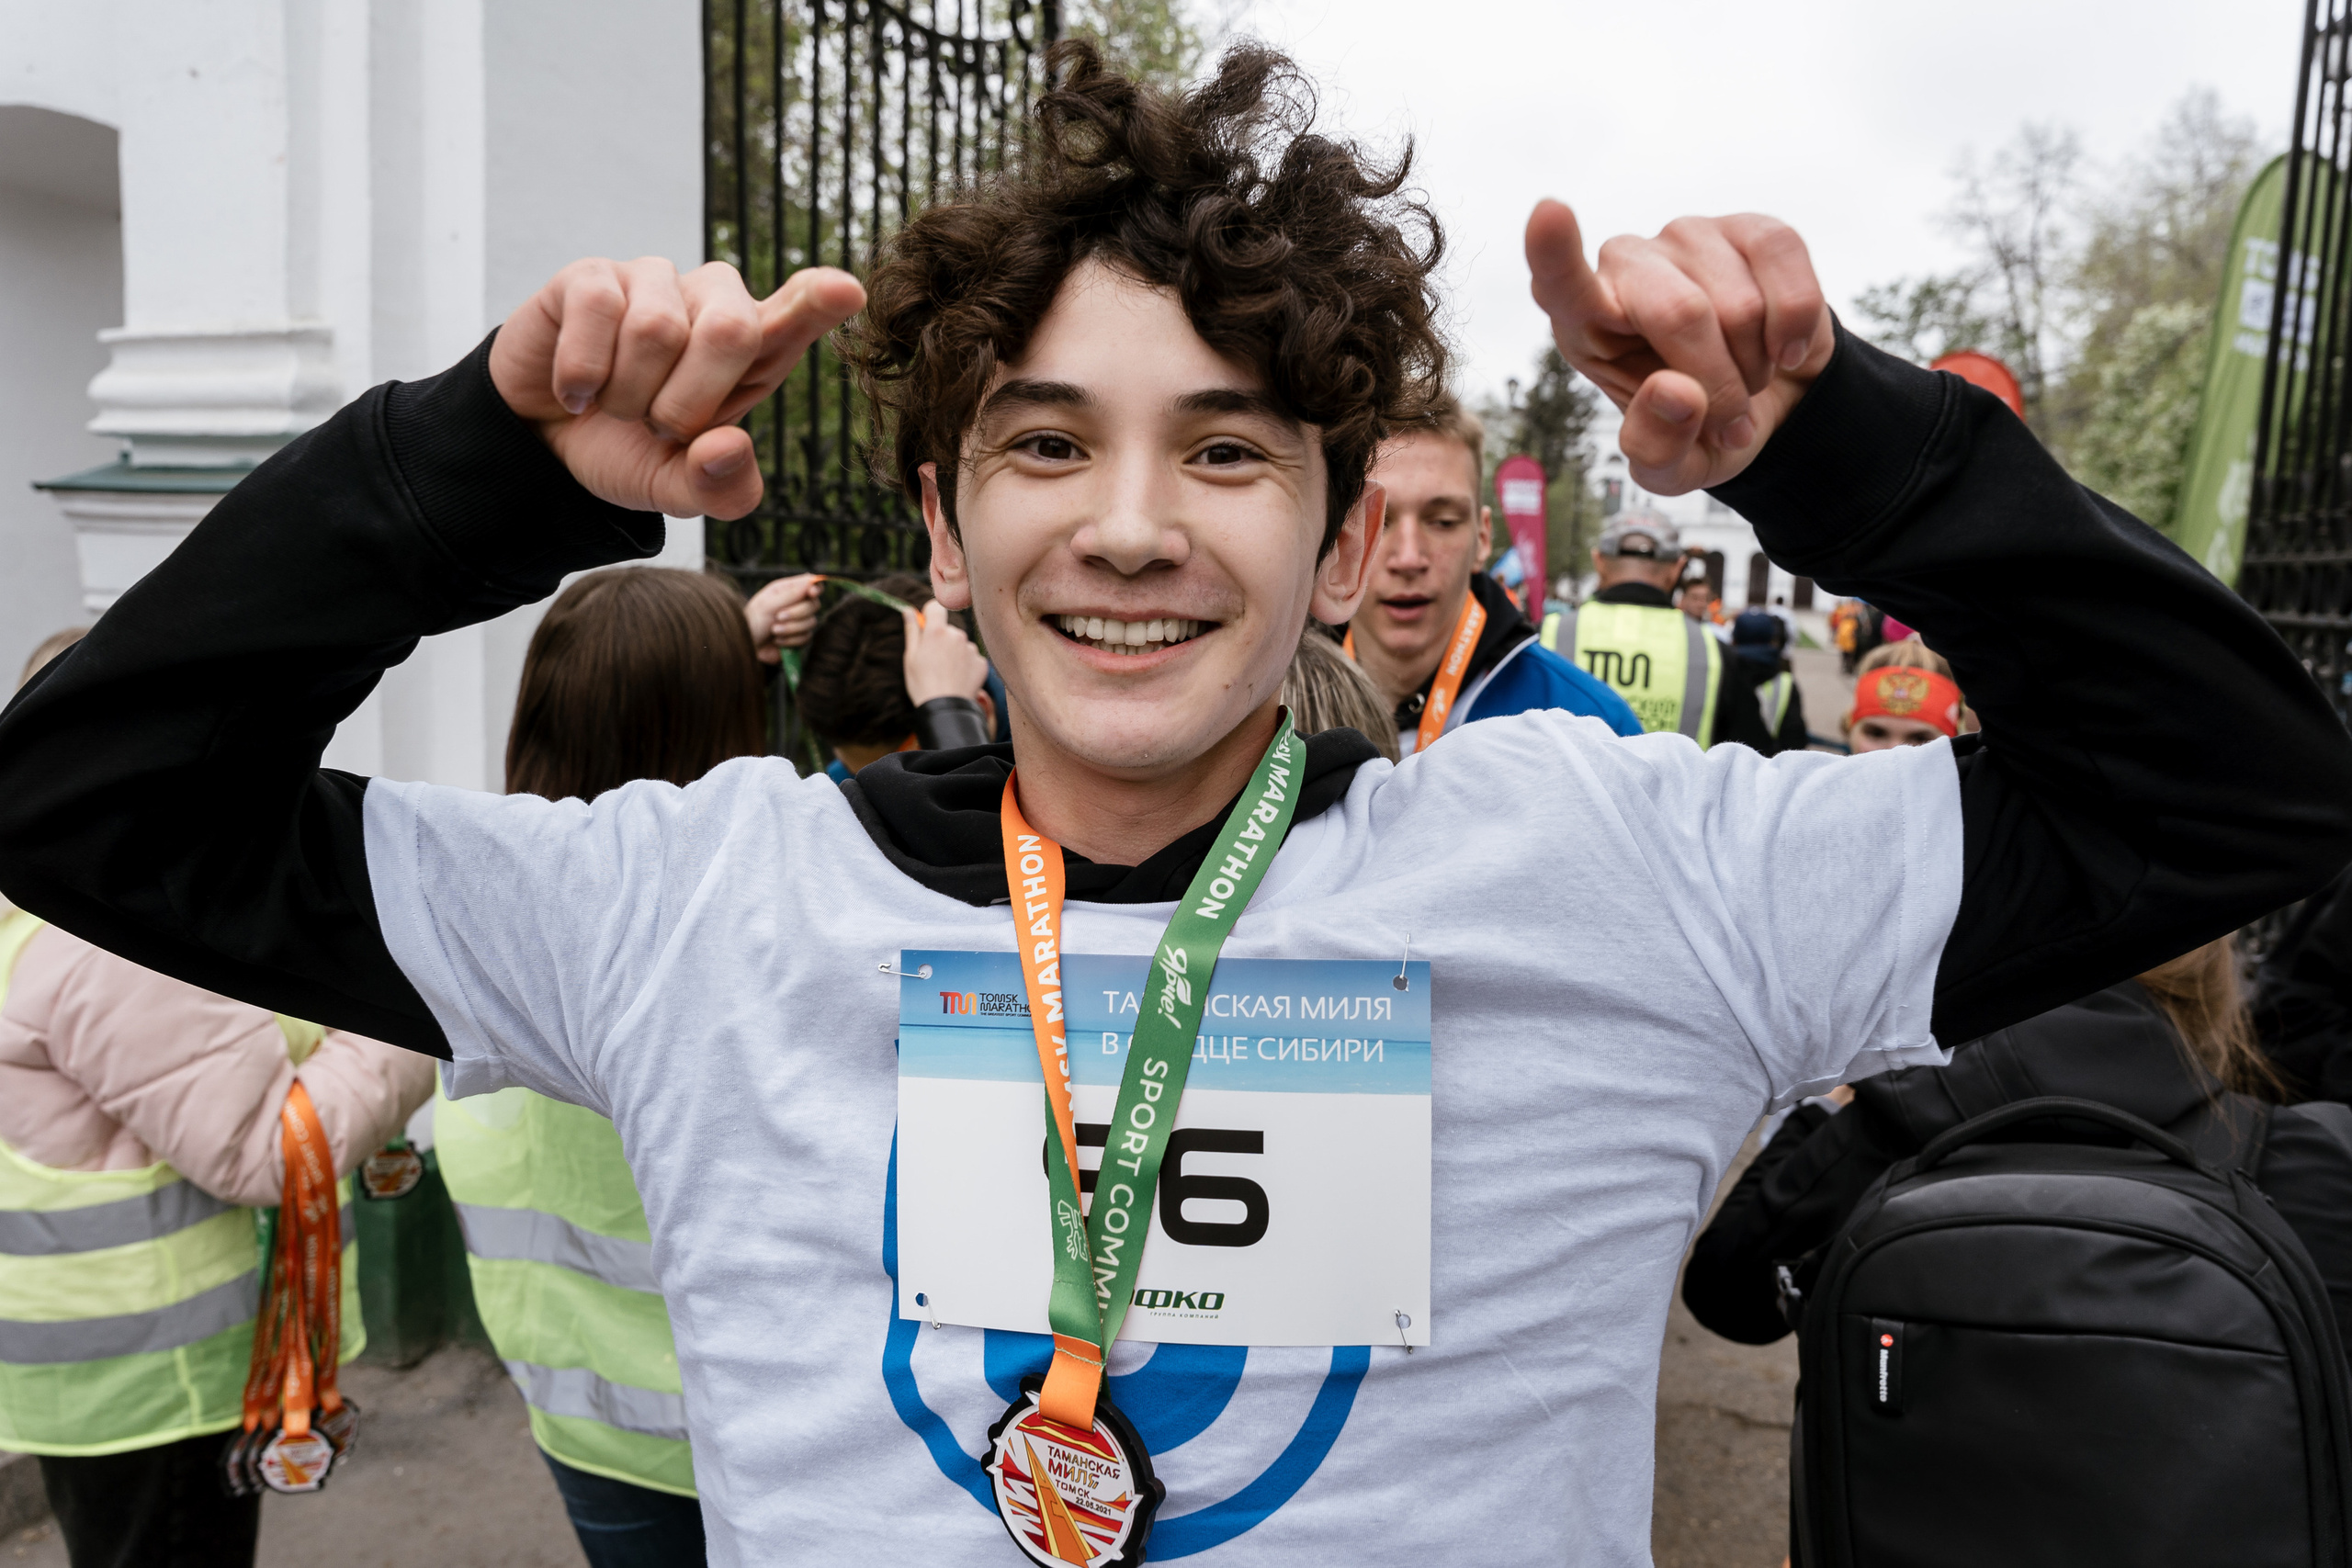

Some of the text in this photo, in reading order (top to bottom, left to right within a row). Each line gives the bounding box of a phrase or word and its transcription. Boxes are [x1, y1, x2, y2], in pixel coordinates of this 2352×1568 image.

[1445, 602, 1482, 676] ARATHON
[1194, 762, 1291, 920] MARATHON
[1017, 833, 1064, 1024] MARATHON
[978, 992, 1019, 1003] TOMSK
[1102, 990, 1392, 1021] ТАСКАЯ МИЛЯ
[1102, 1032, 1119, 1055] В
[1257, 1037, 1384, 1064] СИБИРИ
[1092, 1056, 1170, 1310] SPORT COMM
[1128, 1288, 1226, 1311] ФКО
[1047, 1445, 1121, 1480] ТАМАНСКАЯ
[1047, 1458, 1101, 1490] МИЛЯ
[1056, 1479, 1091, 1499] ТОМСК
[1075, 1496, 1112, 1517] 22.05.2021
